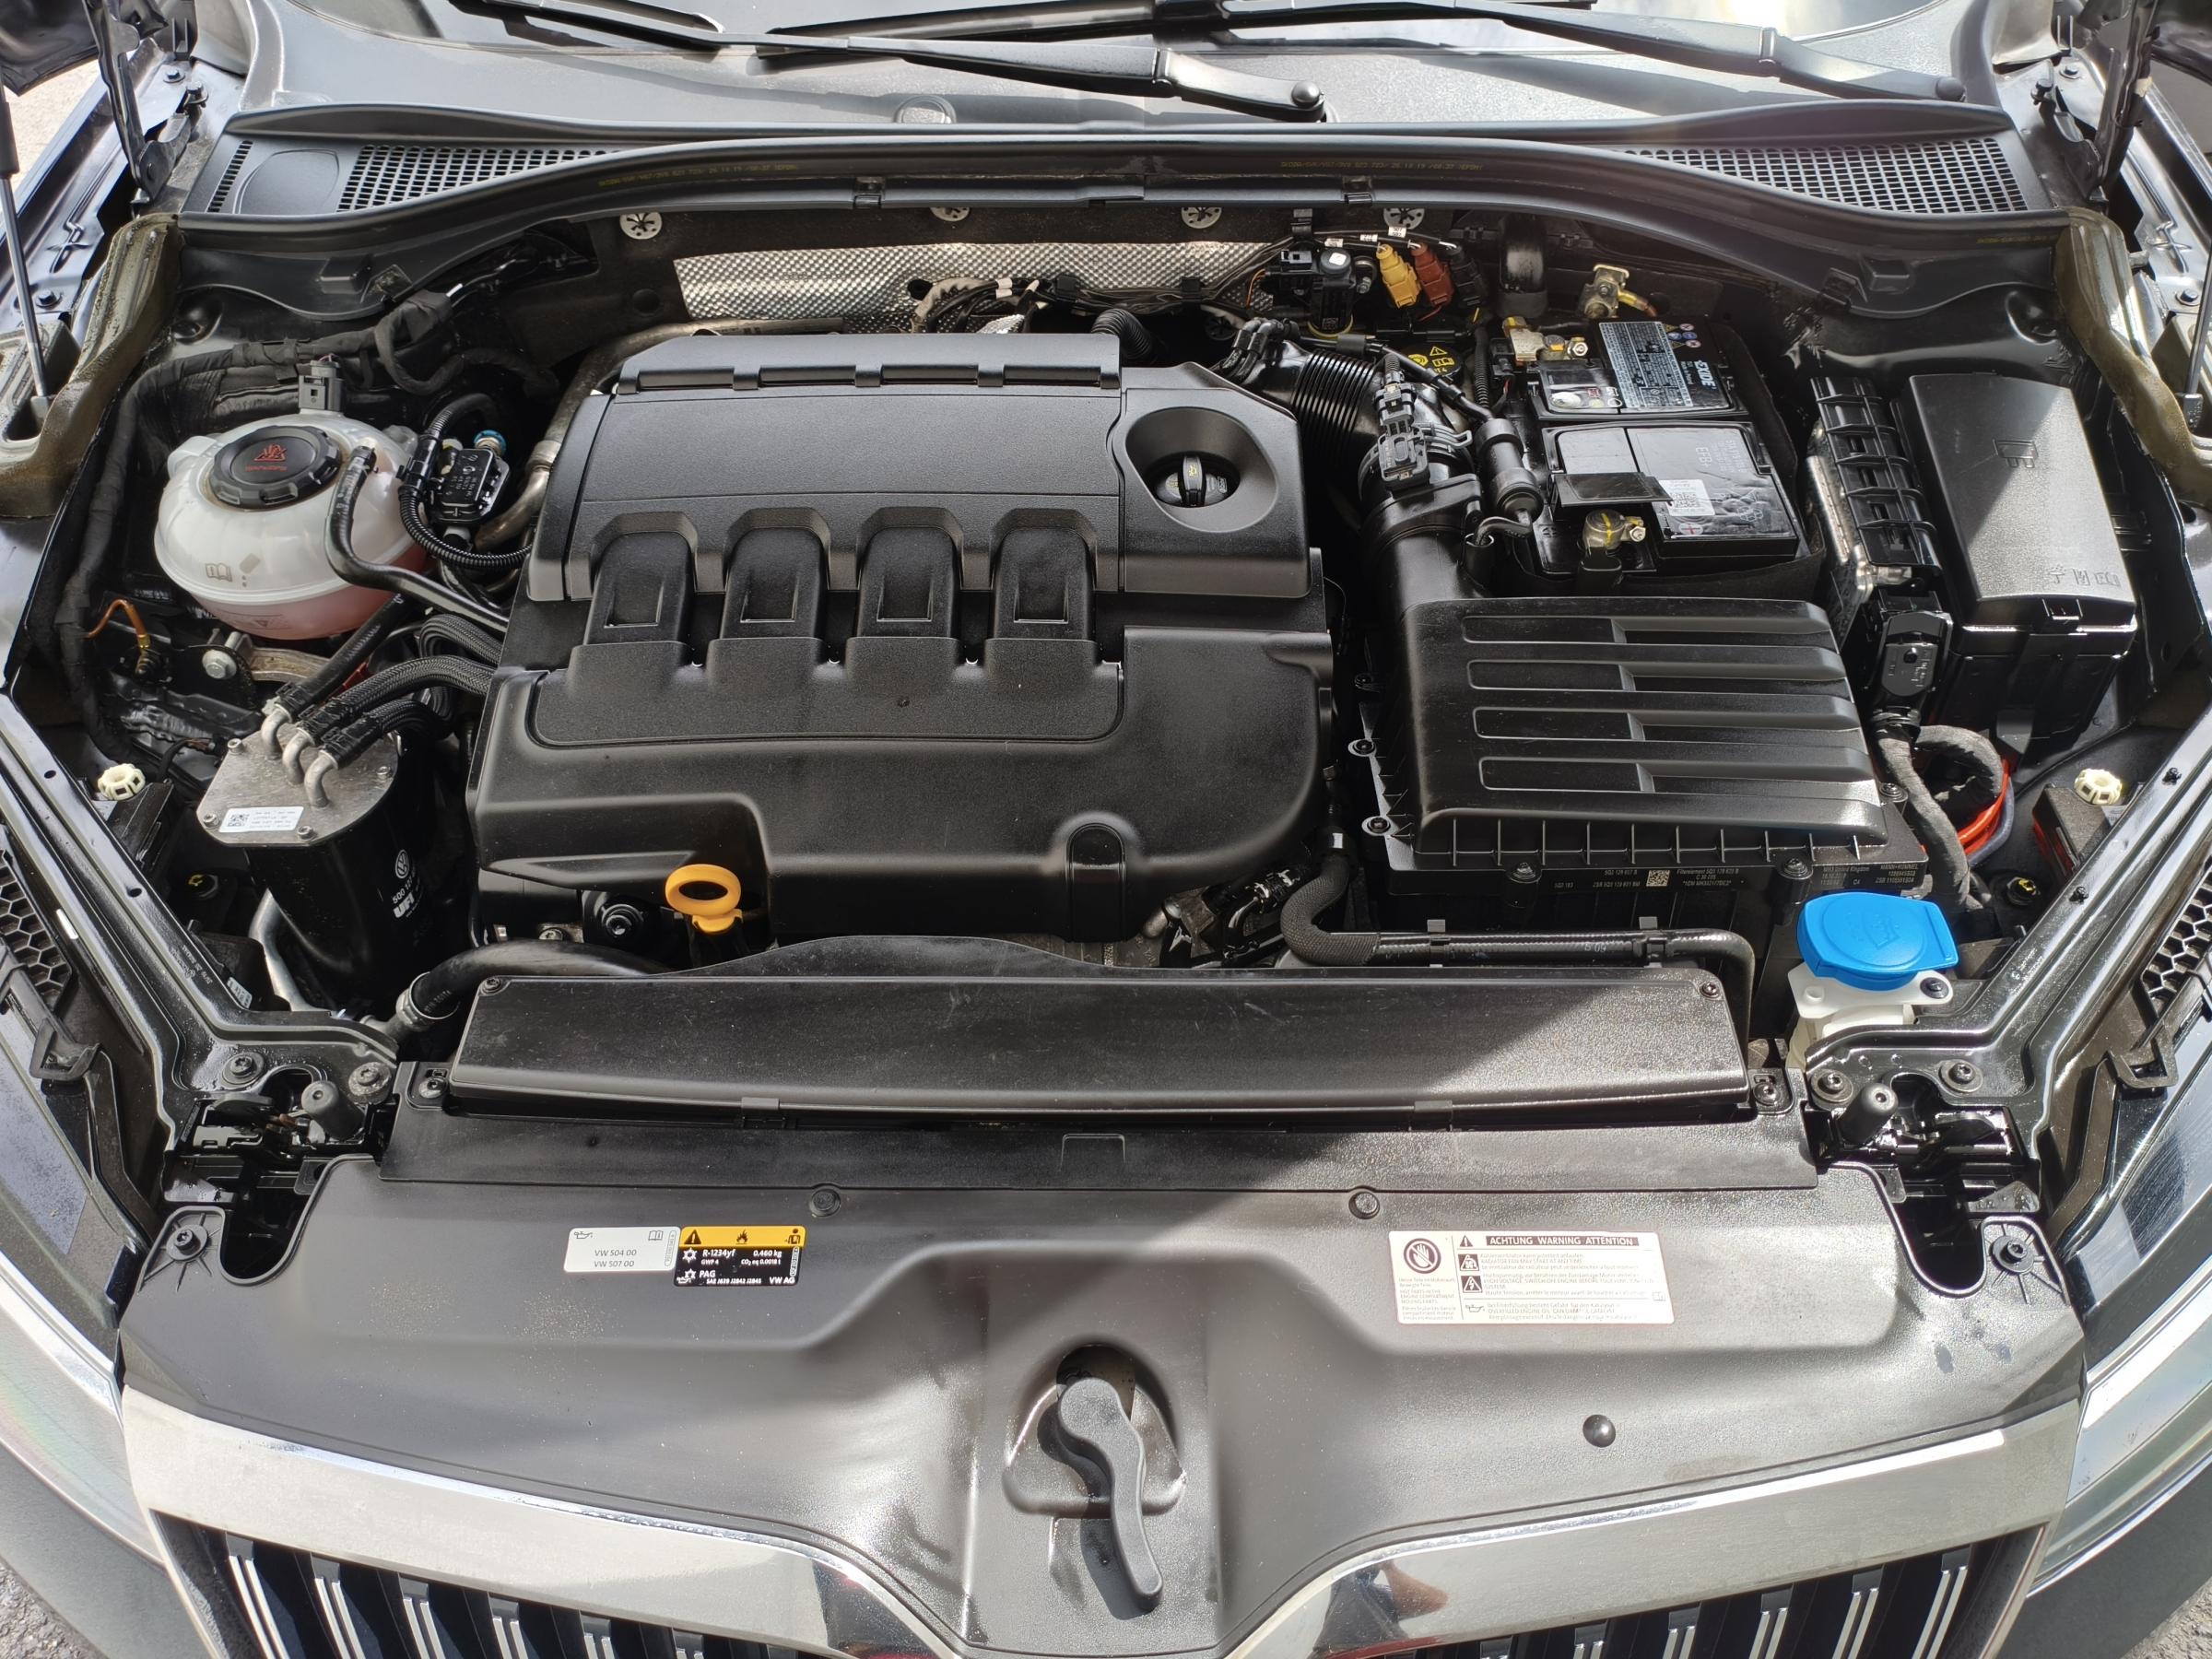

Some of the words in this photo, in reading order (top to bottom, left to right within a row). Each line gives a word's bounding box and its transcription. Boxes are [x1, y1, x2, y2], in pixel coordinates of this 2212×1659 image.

[1489, 1236, 1534, 1246] ACHTUNG
[1537, 1236, 1582, 1246] WARNING
[1585, 1236, 1633, 1246] ATTENTION
[702, 1249, 736, 1259] R-1234yf
[773, 1250, 782, 1258] kg
